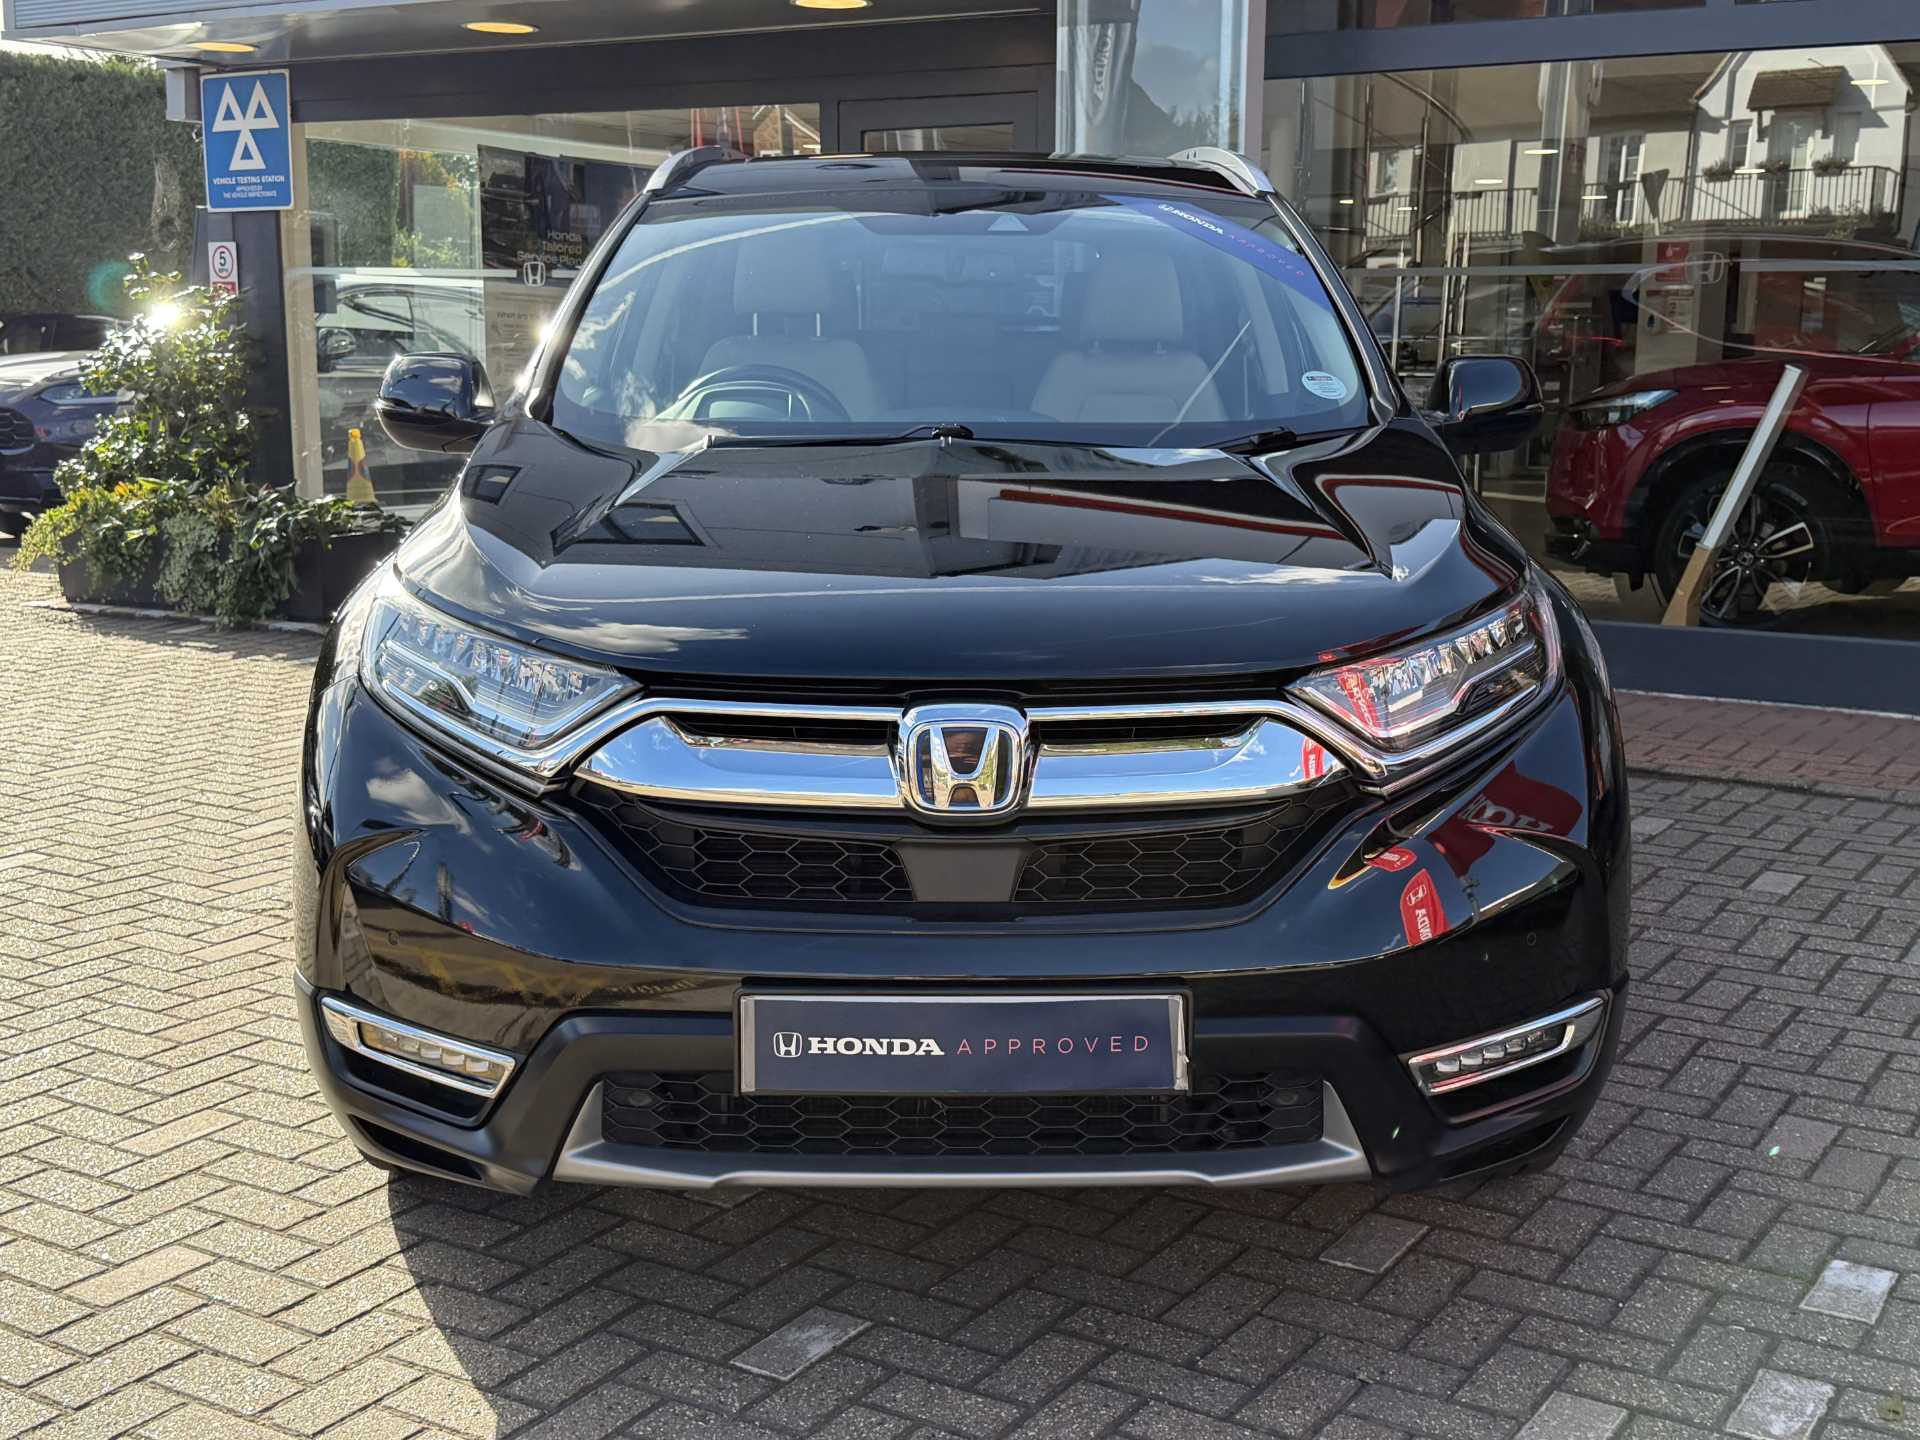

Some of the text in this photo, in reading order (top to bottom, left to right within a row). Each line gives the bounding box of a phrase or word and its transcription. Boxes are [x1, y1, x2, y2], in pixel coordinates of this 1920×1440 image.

[213, 175, 285, 185] VEHICLE TESTING STATION
[547, 230, 582, 242] Honda
[543, 241, 583, 255] Tailored
[219, 251, 226, 266] 5
[808, 1036, 945, 1056] HONDA
[957, 1035, 1150, 1056] APPROVED
